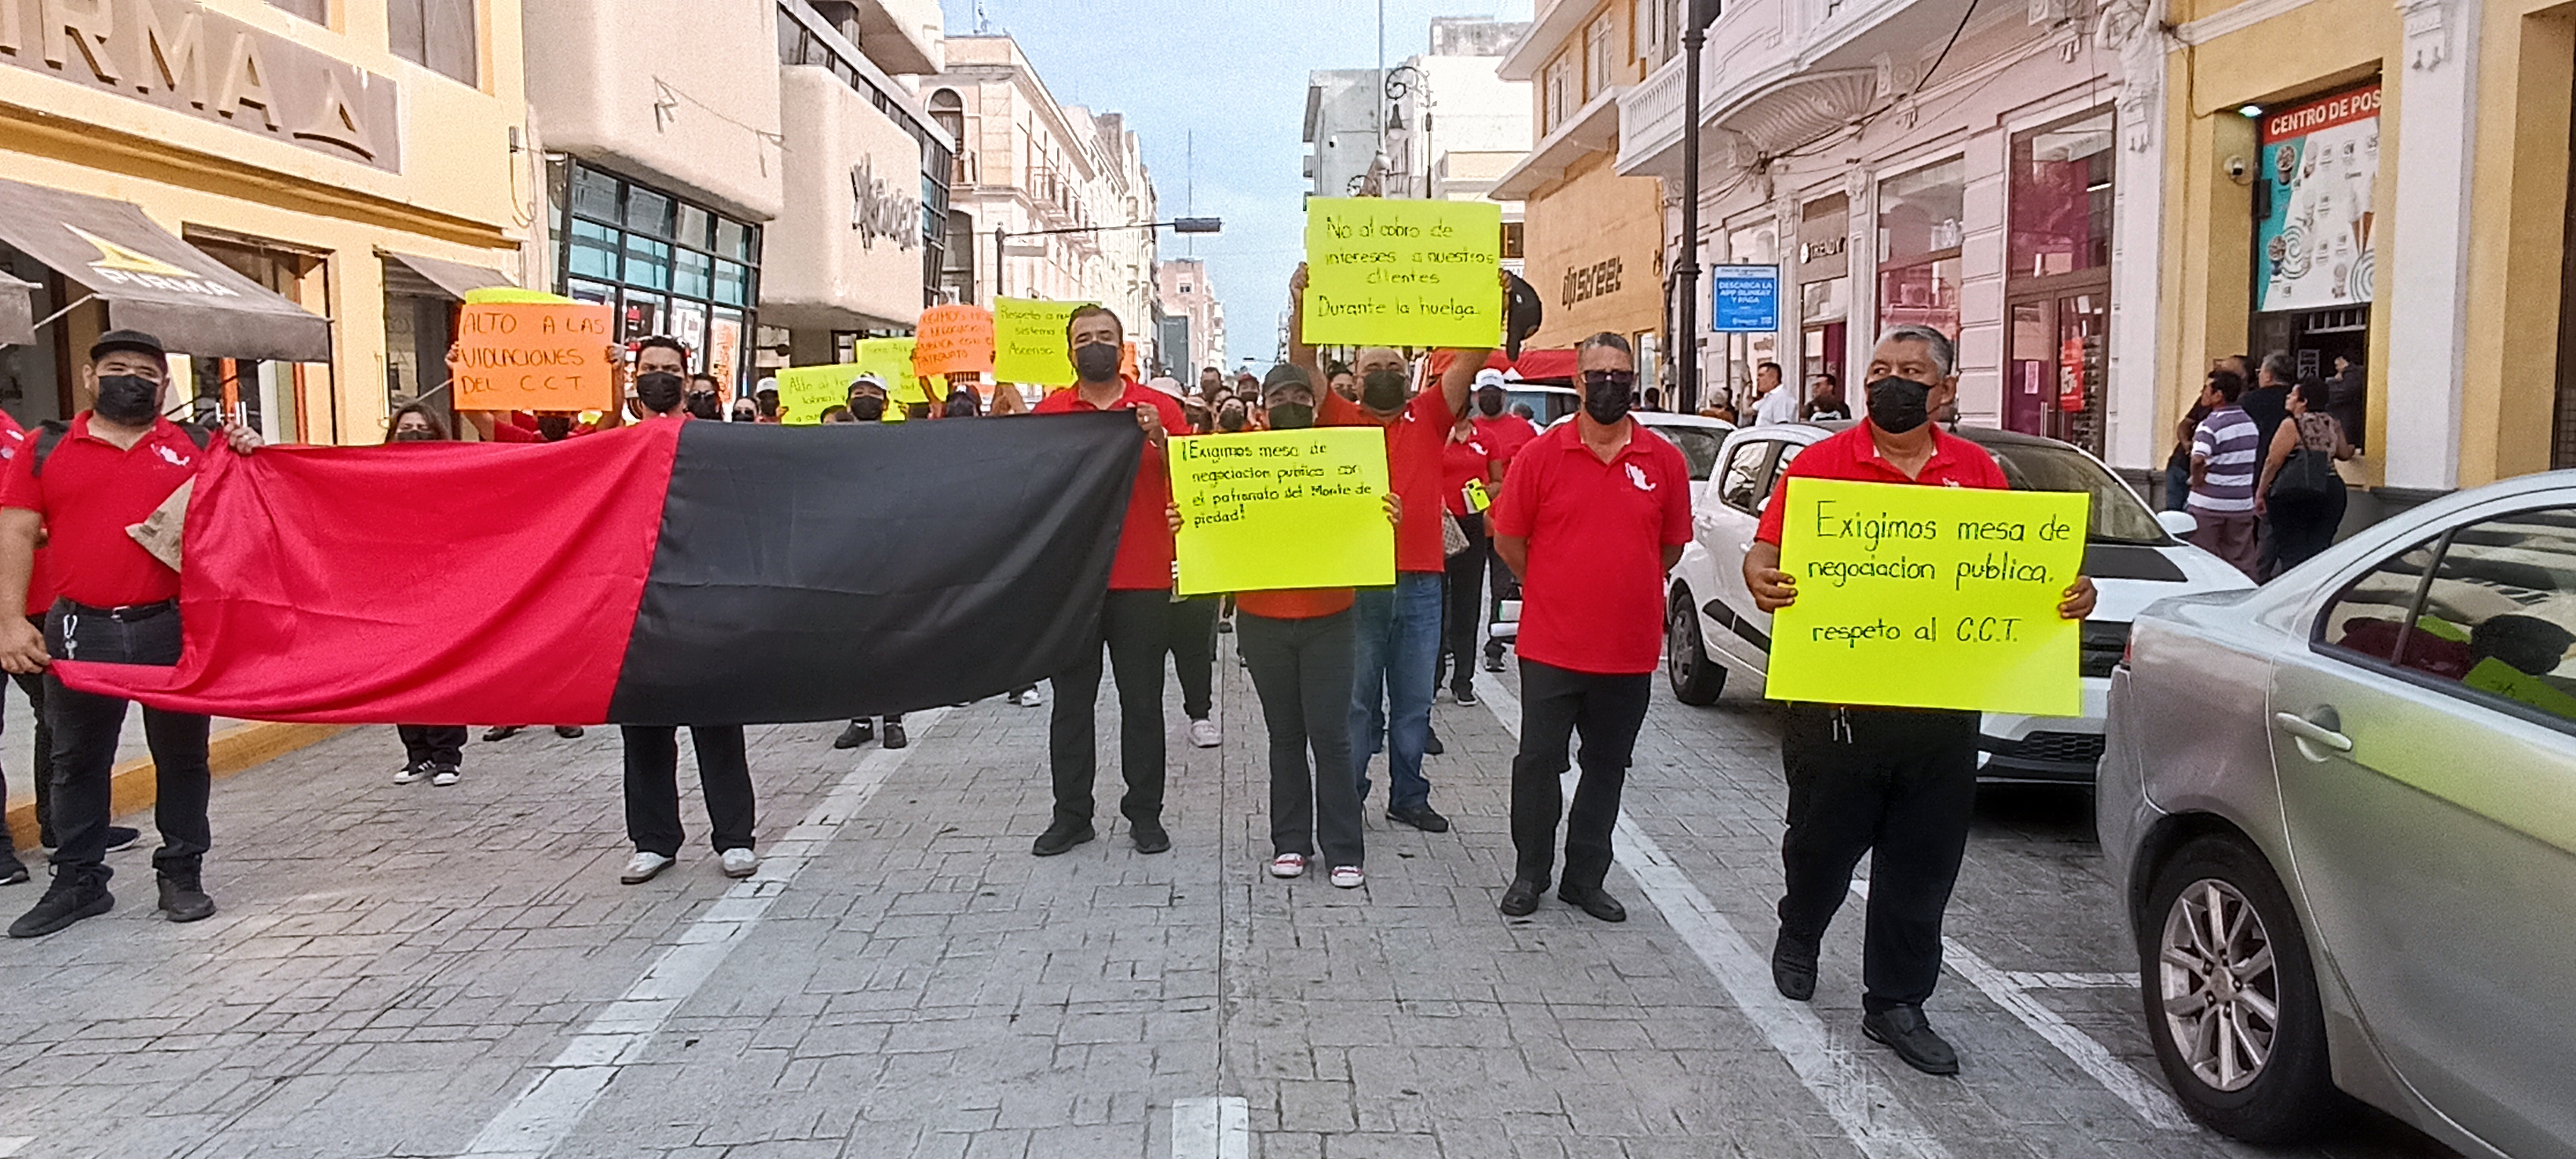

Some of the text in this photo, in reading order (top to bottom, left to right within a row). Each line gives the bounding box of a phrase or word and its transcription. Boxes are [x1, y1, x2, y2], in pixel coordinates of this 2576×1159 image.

[2271, 104, 2326, 135] CENTRO
[2329, 98, 2349, 120] DE
[1326, 215, 1453, 239] No al cobro de
[1326, 247, 1495, 265] intereses a nuestros
[1366, 267, 1440, 284] clientes
[1318, 294, 1387, 317] Durante
[1396, 297, 1411, 315] la
[463, 313, 605, 335] ALTO A LAS
[461, 347, 584, 369] VIOLACIONES
[461, 375, 496, 394] DEL
[1259, 444, 1300, 458] mesa
[1309, 441, 1326, 455] de
[1192, 464, 1360, 488] negociacion publica con
[1192, 492, 1206, 506] el
[1284, 485, 1303, 499] del
[1311, 484, 1351, 497] Monte
[1355, 482, 1373, 495] de
[1194, 503, 1246, 528] piedad!
[1817, 500, 2071, 551] Exigimos mesa de
[1808, 551, 2054, 590] negociacion publica.
[1813, 616, 2022, 649] respeto al C.C.T.
